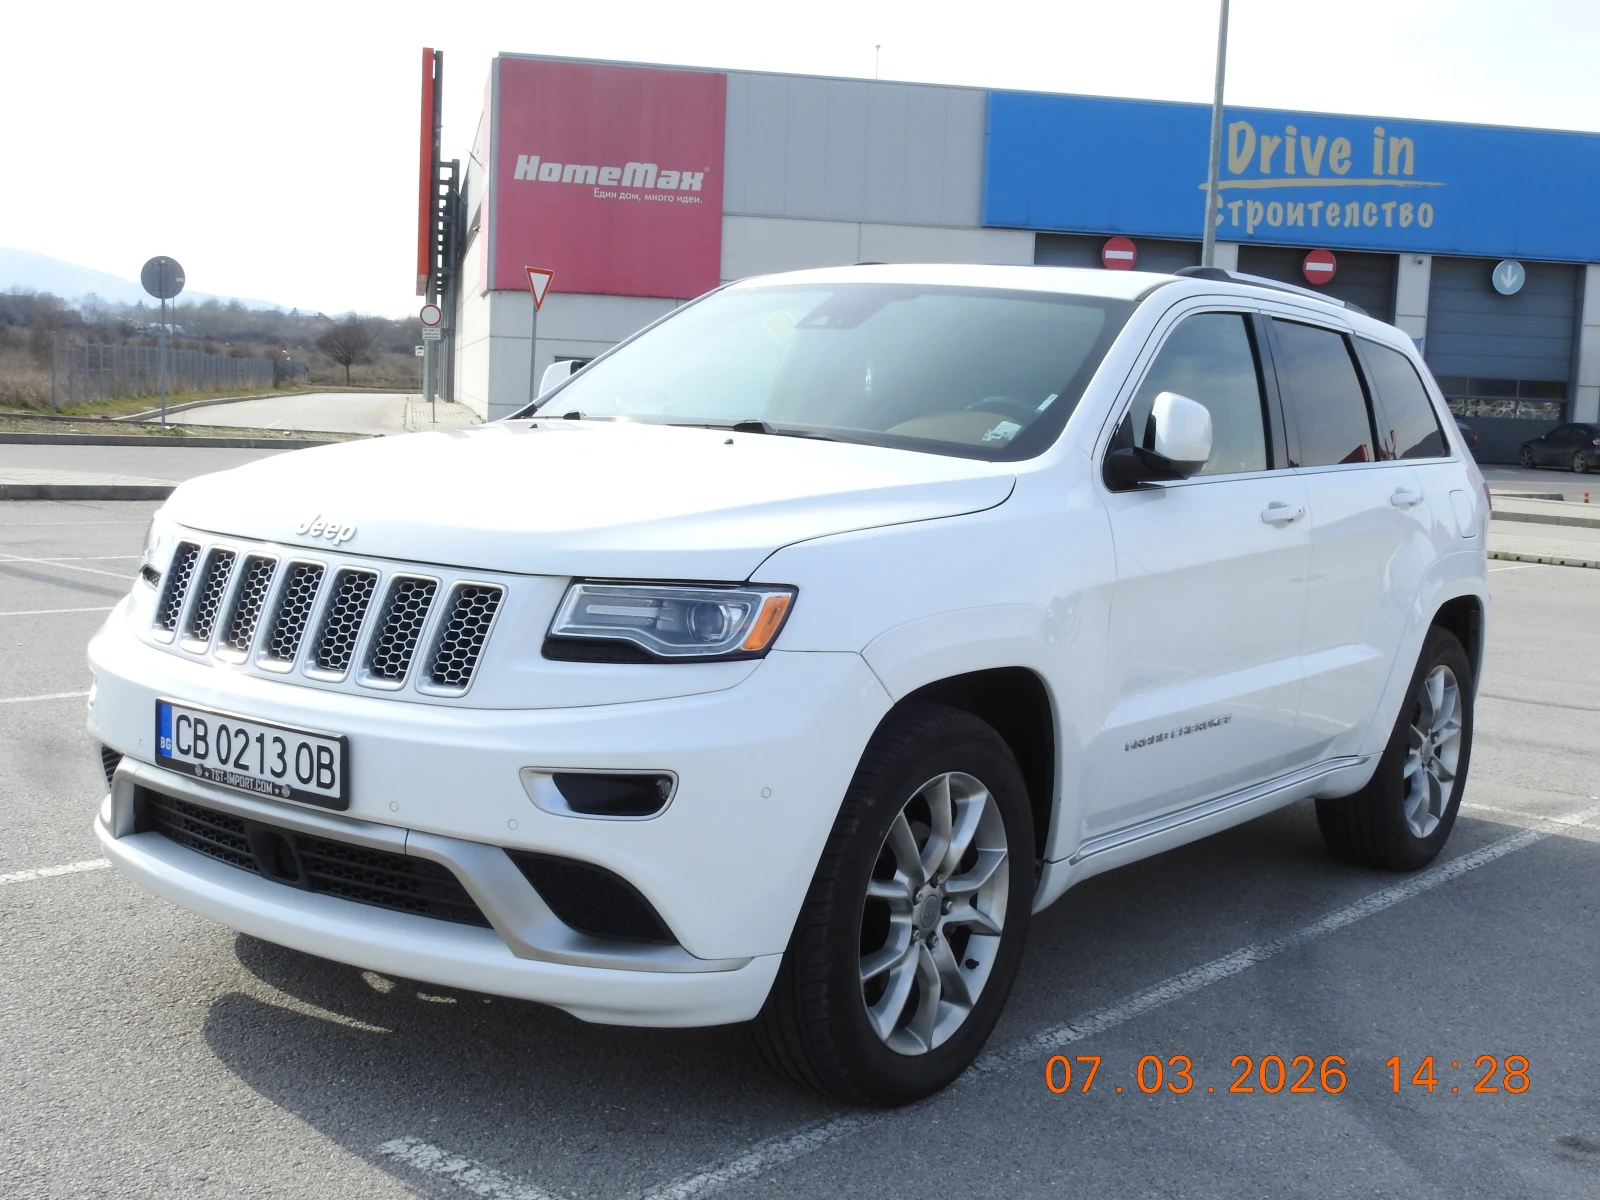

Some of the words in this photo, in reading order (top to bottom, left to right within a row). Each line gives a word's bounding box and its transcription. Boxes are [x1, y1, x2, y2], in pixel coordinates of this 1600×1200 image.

[1227, 120, 1352, 176] Drive
[1372, 126, 1415, 176] in
[514, 154, 704, 191] HomeMax
[593, 187, 617, 199] Един
[619, 192, 641, 201] дом,
[644, 193, 674, 202] много
[676, 195, 703, 204] идеи.
[296, 514, 358, 546] Jeep
[160, 736, 172, 751] BG
[216, 723, 288, 779] 0213
[211, 768, 273, 795] TST-IMPORT.COM
